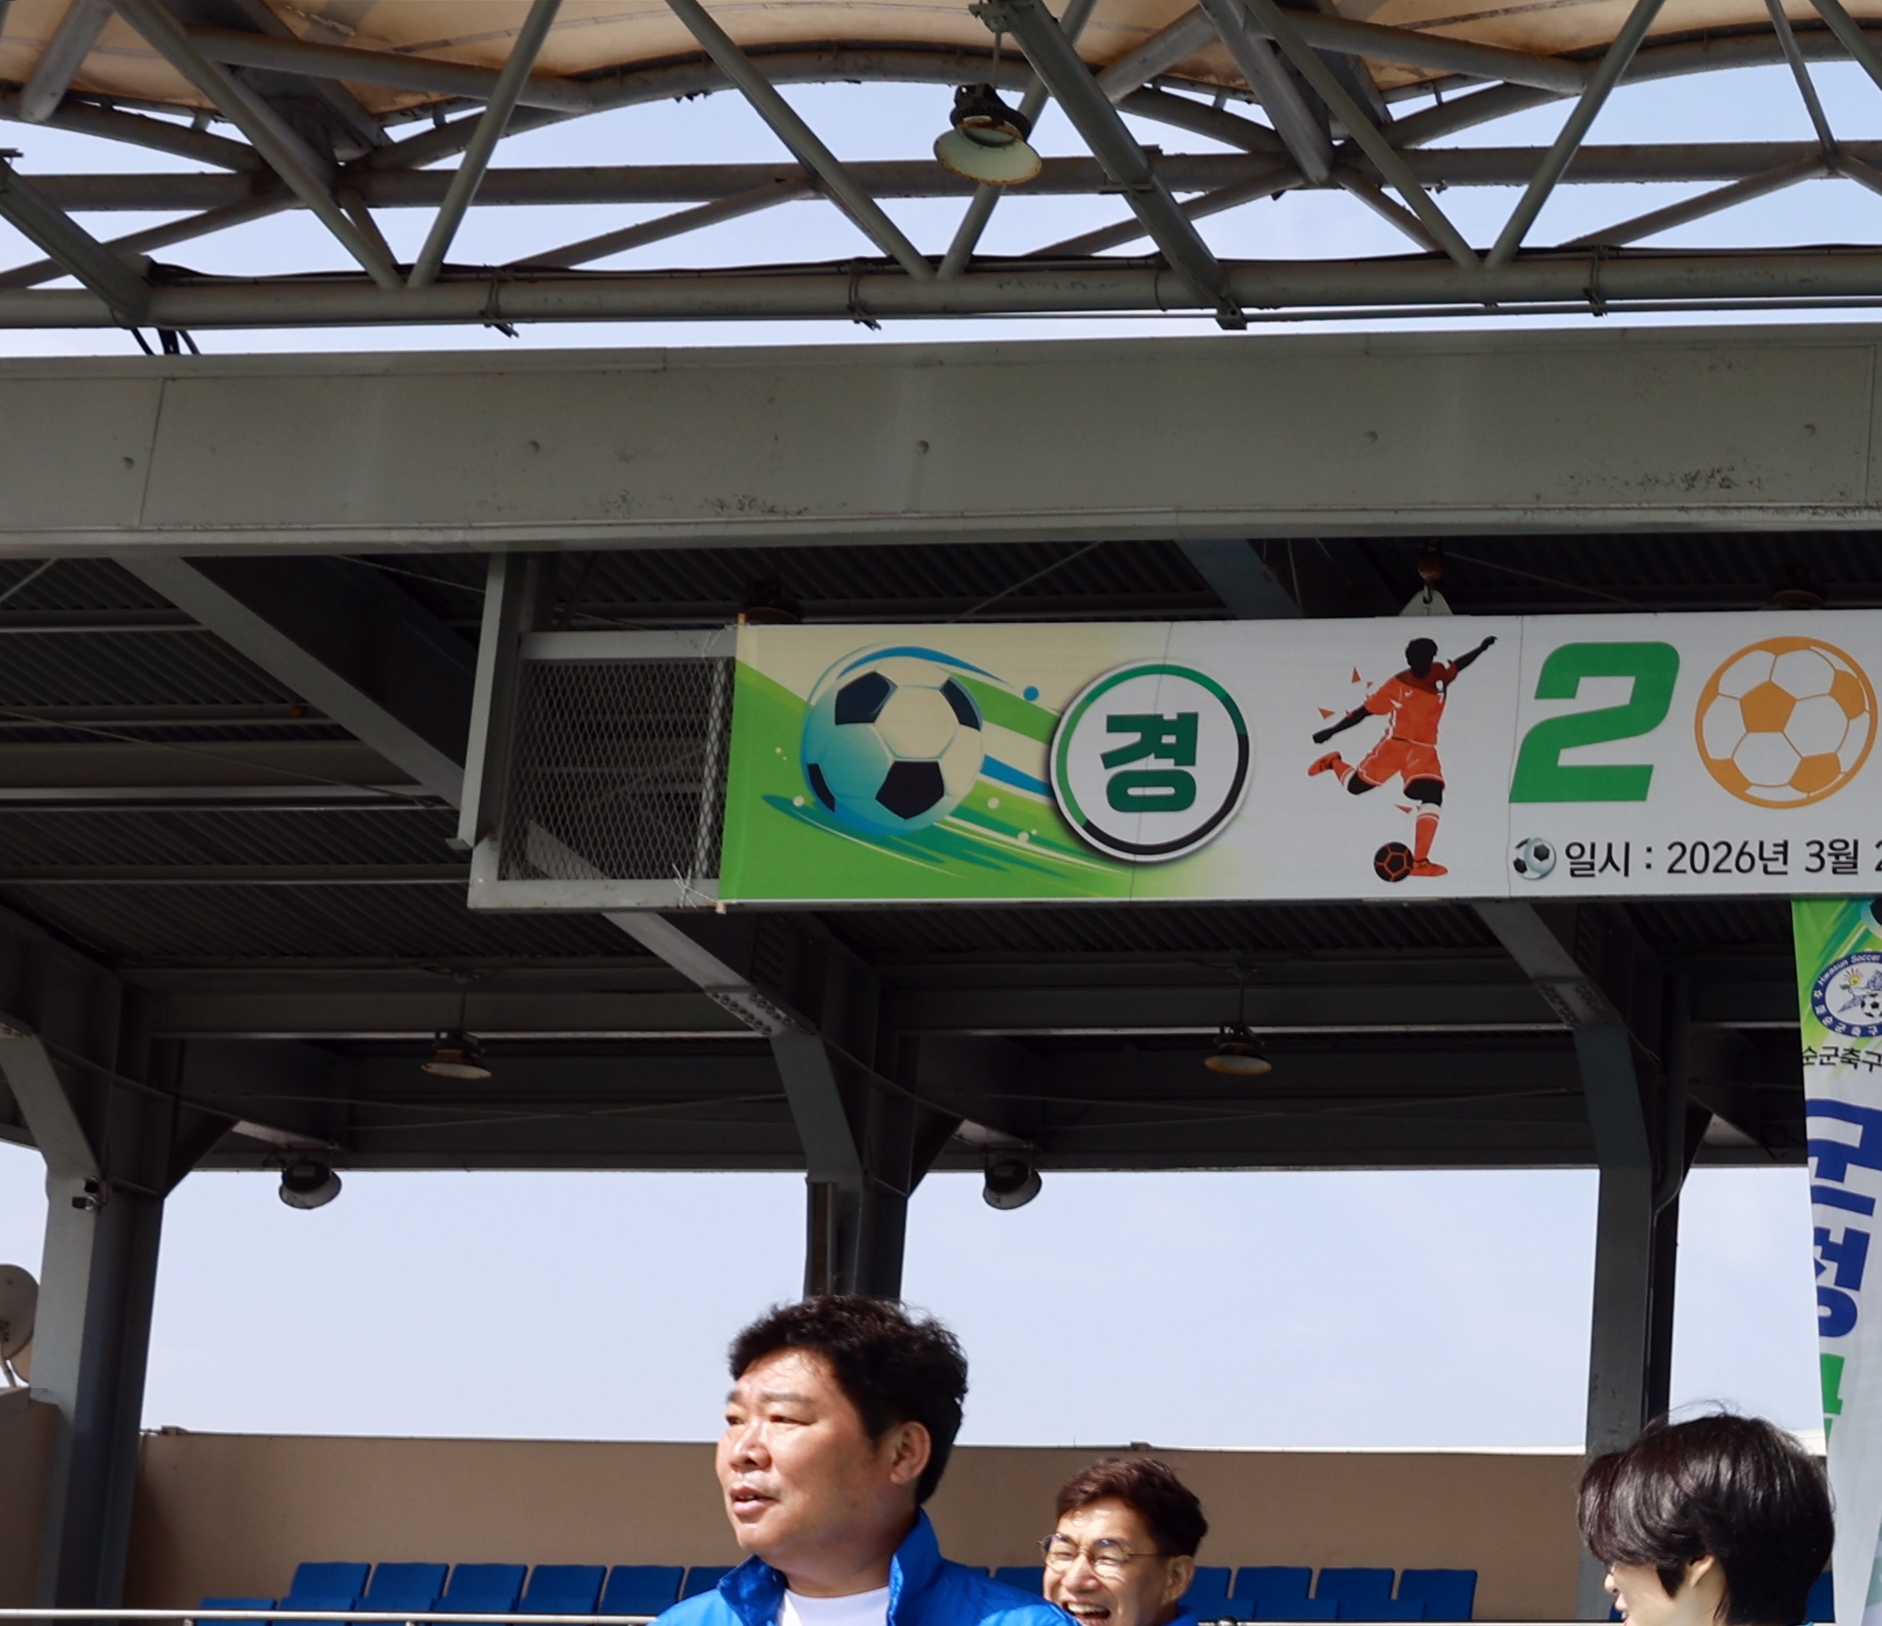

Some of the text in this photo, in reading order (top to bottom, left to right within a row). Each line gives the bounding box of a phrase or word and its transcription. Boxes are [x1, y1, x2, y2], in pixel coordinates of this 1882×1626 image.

[1100, 712, 1199, 813] 경
[1564, 840, 1631, 877] 일시
[1666, 839, 1790, 876] 2026년
[1805, 838, 1860, 875] 3월
